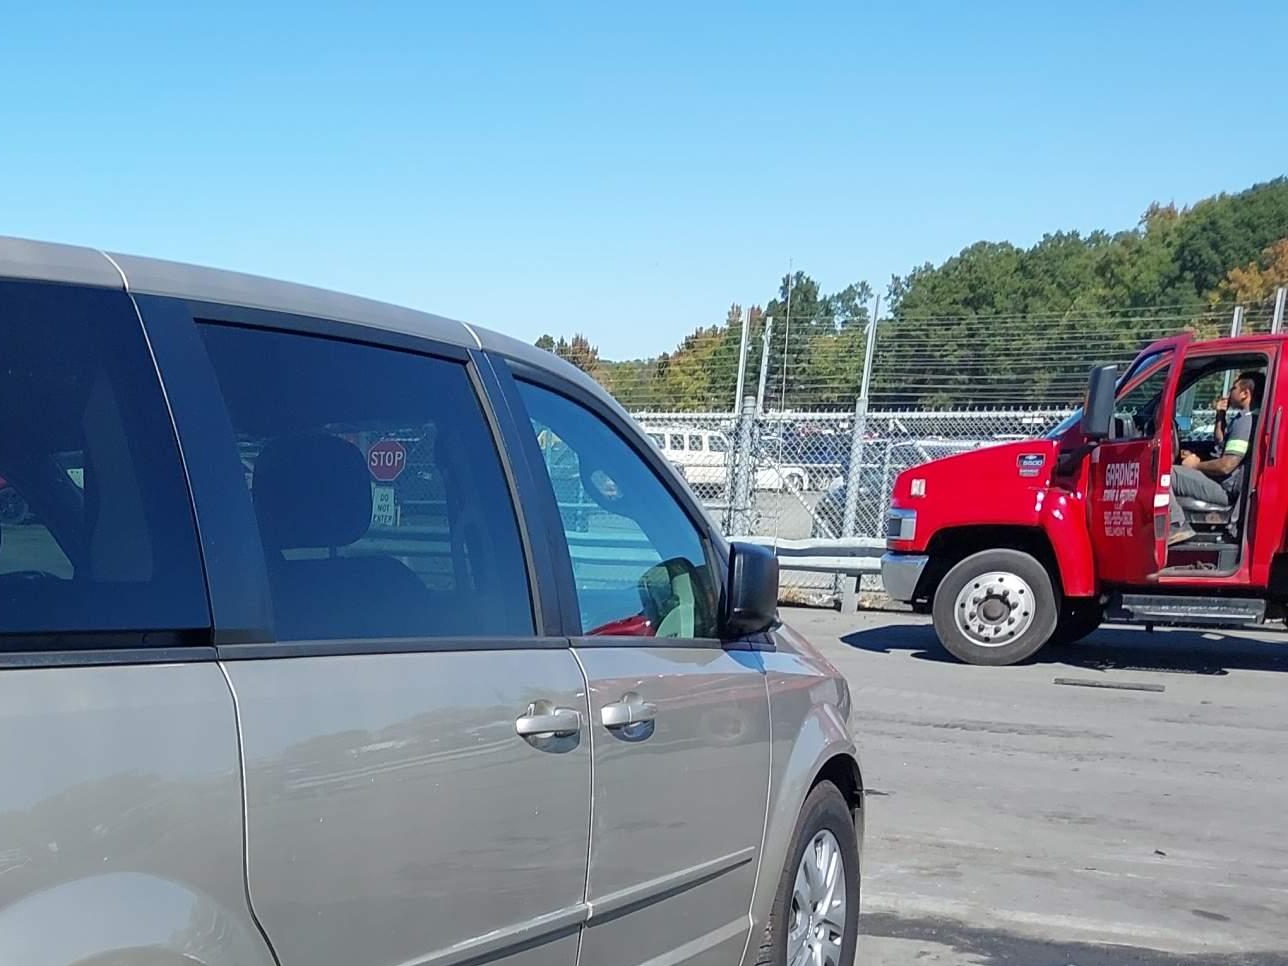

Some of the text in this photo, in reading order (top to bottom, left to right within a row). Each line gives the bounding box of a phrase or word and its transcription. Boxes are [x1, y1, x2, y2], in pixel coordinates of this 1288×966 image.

[371, 451, 403, 467] STOP
[1106, 462, 1140, 489] GARDNER
[380, 494, 389, 502] DO
[378, 504, 389, 512] NOT
